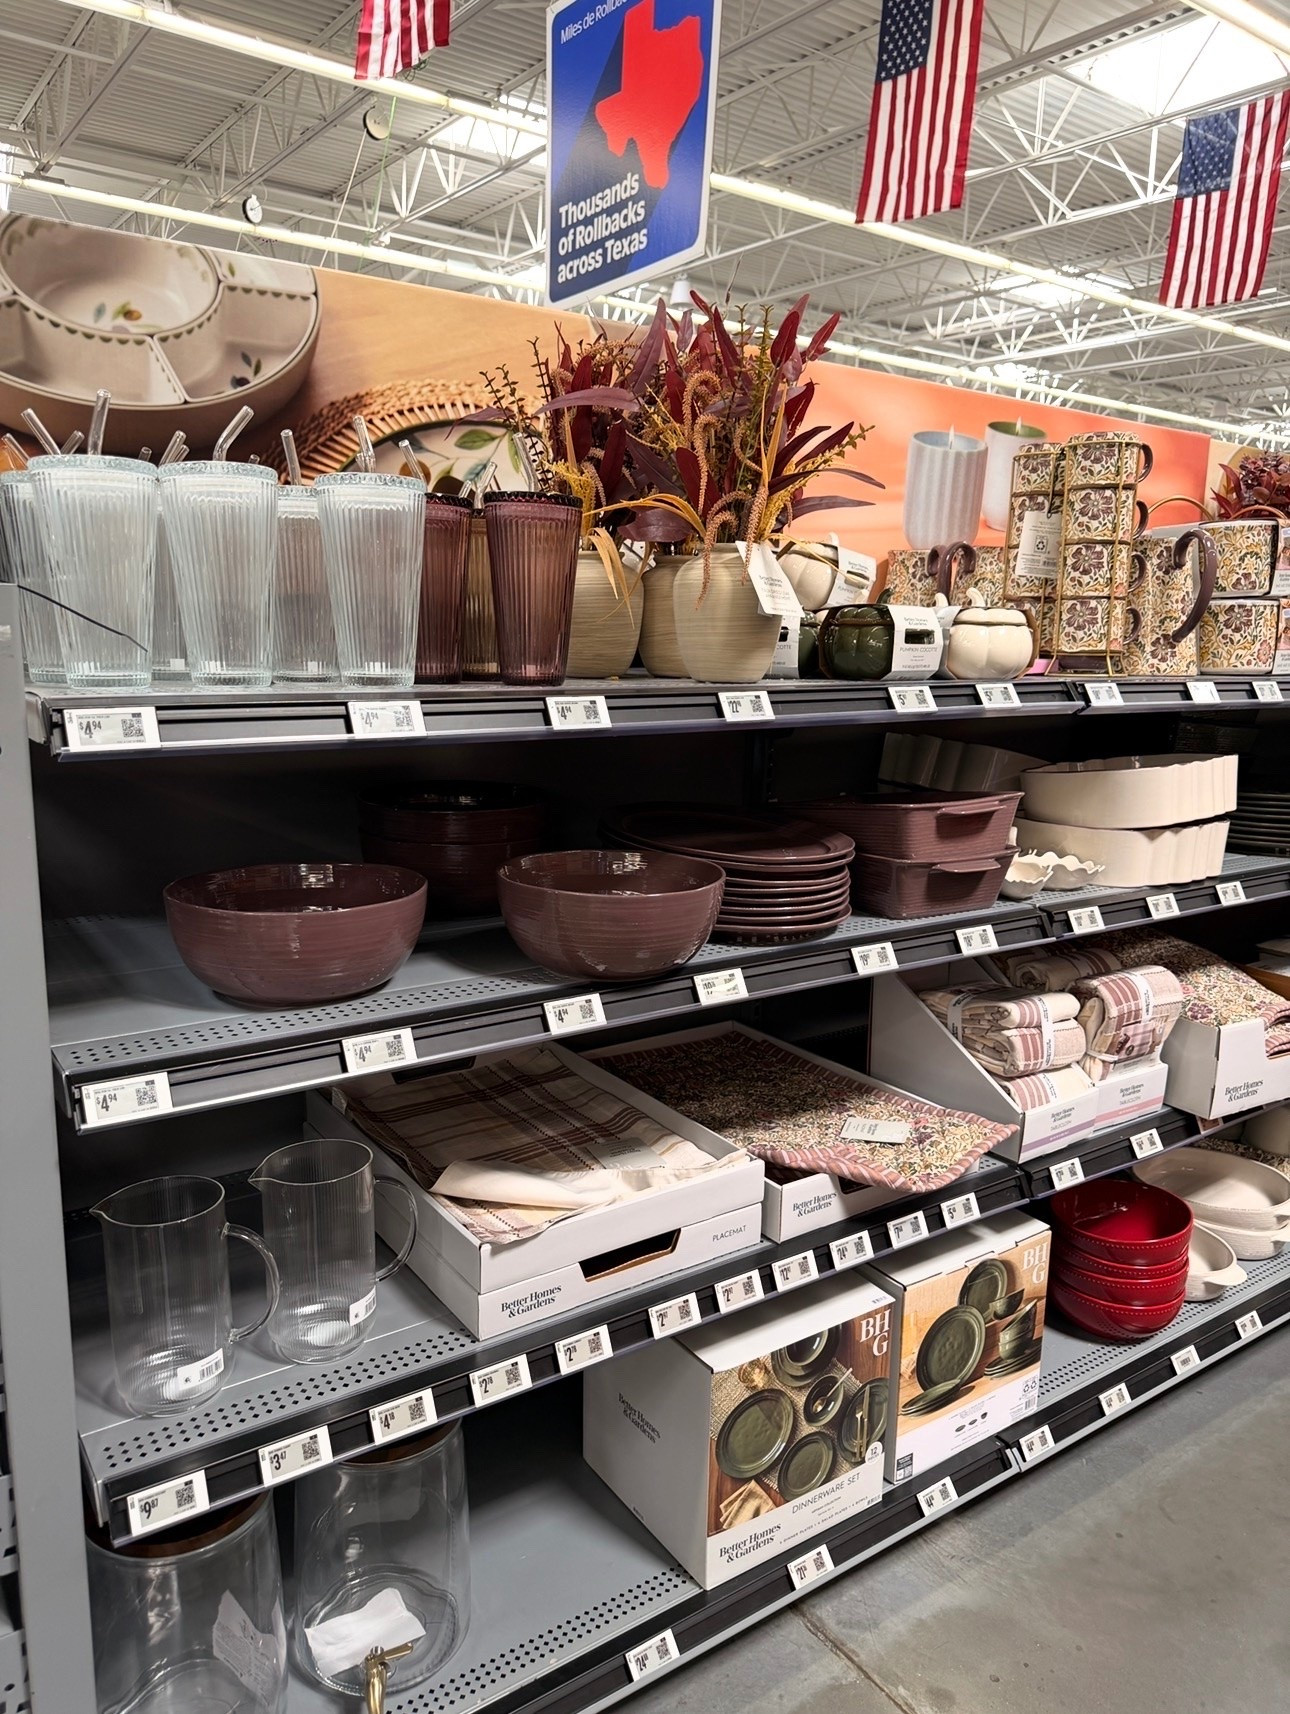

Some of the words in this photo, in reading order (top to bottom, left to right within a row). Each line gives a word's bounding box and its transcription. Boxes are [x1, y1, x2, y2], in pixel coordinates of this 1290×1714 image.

[560, 20, 582, 44] Miles
[583, 11, 595, 29] de
[559, 172, 640, 229] Thousands
[558, 228, 575, 256] of
[575, 200, 646, 249] Rollbacks
[557, 248, 604, 283] across
[605, 228, 648, 263] Texas
[793, 1200, 813, 1212] Better
[813, 1192, 837, 1205] Homes
[803, 1201, 832, 1215] Gardens
[712, 1224, 747, 1242] PLACEMAT
[501, 1297, 529, 1313] Better
[530, 1285, 562, 1303] Homes
[508, 1308, 516, 1318] &
[516, 1296, 556, 1315] Gardens
[792, 1480, 845, 1514] DINNERWARE
[847, 1472, 860, 1486] SET
[720, 1538, 749, 1558] Better
[749, 1524, 781, 1545] Homes
[726, 1552, 734, 1563] &
[735, 1535, 775, 1559] Gardens
